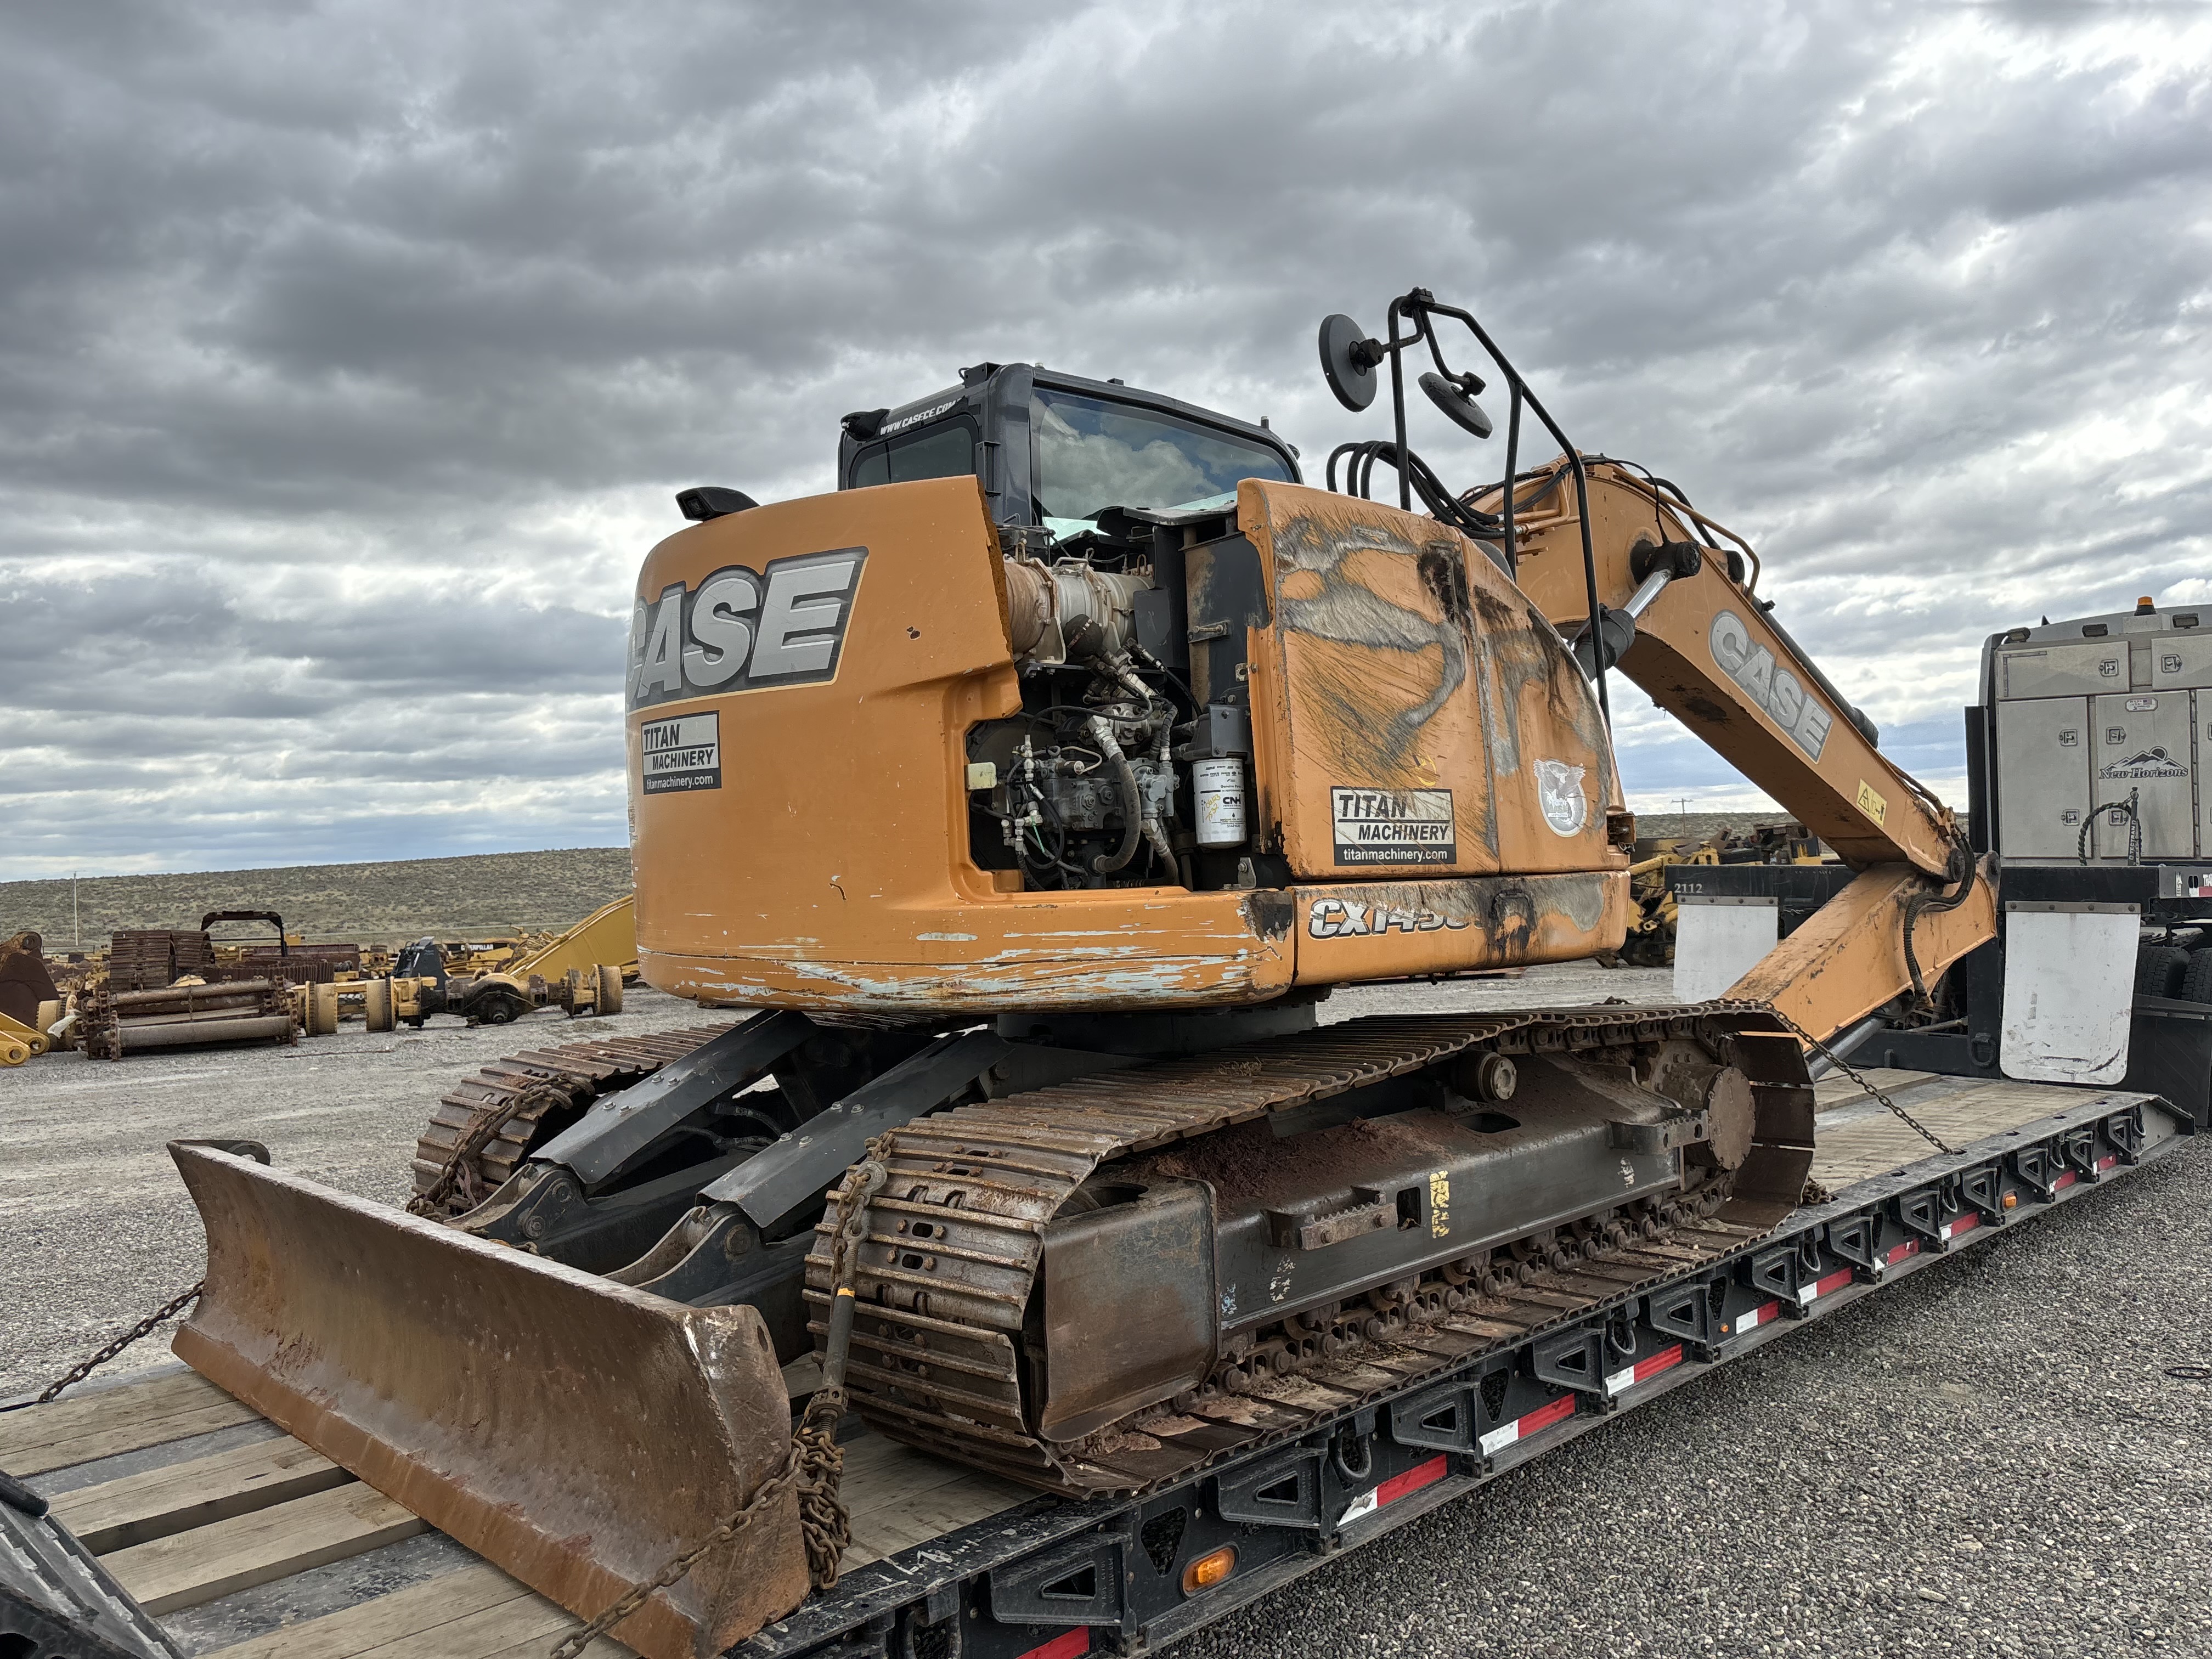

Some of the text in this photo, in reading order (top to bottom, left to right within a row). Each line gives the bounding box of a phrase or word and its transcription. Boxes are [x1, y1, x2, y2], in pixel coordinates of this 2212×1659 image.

[1711, 616, 1831, 758] CASE
[644, 723, 680, 751] TITAN
[652, 748, 714, 771] MACHINERY
[2099, 766, 2188, 779] New Horizons
[646, 775, 713, 790] titanmachinery.com
[1222, 793, 1242, 805] CNH
[1338, 794, 1408, 818] TITAN
[1358, 824, 1449, 841] MACHINERY
[1343, 848, 1448, 862] titanmachinery.com
[1674, 883, 1703, 894] 2112
